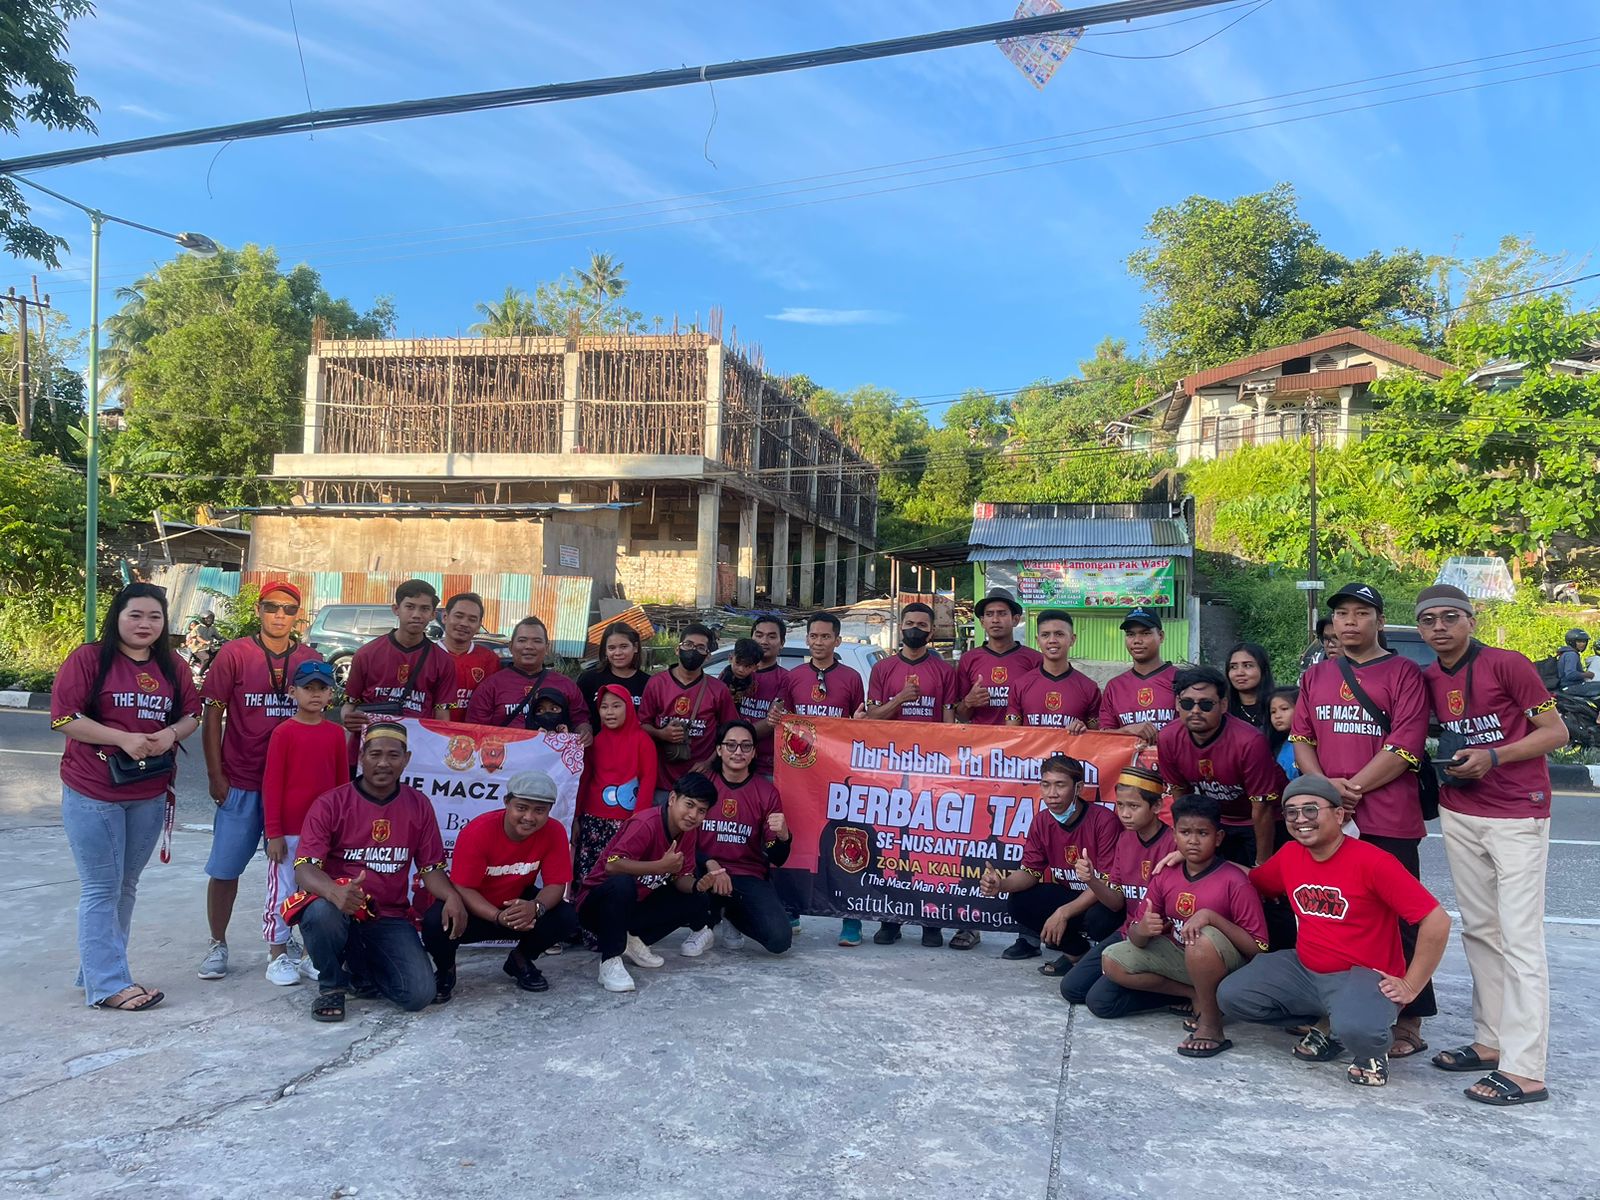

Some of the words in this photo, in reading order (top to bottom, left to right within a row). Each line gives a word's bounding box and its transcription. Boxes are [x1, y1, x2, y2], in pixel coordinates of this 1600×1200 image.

[1024, 560, 1061, 571] Warung
[1063, 560, 1116, 571] Lamongan
[1118, 561, 1138, 570] Pak
[1141, 559, 1169, 569] Wasis
[112, 692, 135, 707] THE
[244, 693, 263, 706] THE
[264, 693, 290, 706] MAZ
[988, 687, 1010, 697] MACZ
[137, 709, 166, 722] INDONE
[266, 707, 298, 717] INDONE
[795, 704, 805, 715] THE
[807, 704, 828, 716] MACZ
[829, 706, 843, 717] MAN
[1119, 712, 1134, 726] THE
[1135, 710, 1156, 723] MACZ
[1315, 705, 1331, 720] THE
[1332, 705, 1360, 721] MACZ
[1027, 714, 1039, 725] THE
[1041, 714, 1062, 726] MACZ
[1472, 712, 1502, 732] MAN
[1333, 722, 1382, 737] INDONESIA
[958, 746, 983, 777] Ya
[431, 779, 500, 801] MACZ
[828, 782, 976, 834] BERBAGI
[702, 819, 716, 831] THE
[716, 820, 737, 833] MACZ
[876, 831, 998, 860] SE-NUSANTARA
[1003, 843, 1024, 862] ED
[343, 848, 364, 860] THE
[364, 847, 392, 862] MACZ
[876, 856, 922, 873] ZONA
[1051, 867, 1065, 880] THE
[868, 873, 885, 886] The
[887, 876, 911, 890] Macz
[912, 880, 934, 893] Man
[936, 882, 946, 894] &
[949, 883, 968, 896] The
[1122, 884, 1138, 899] THE
[847, 894, 914, 916] satukan
[921, 900, 953, 921] hati
[960, 904, 1019, 928] denga
